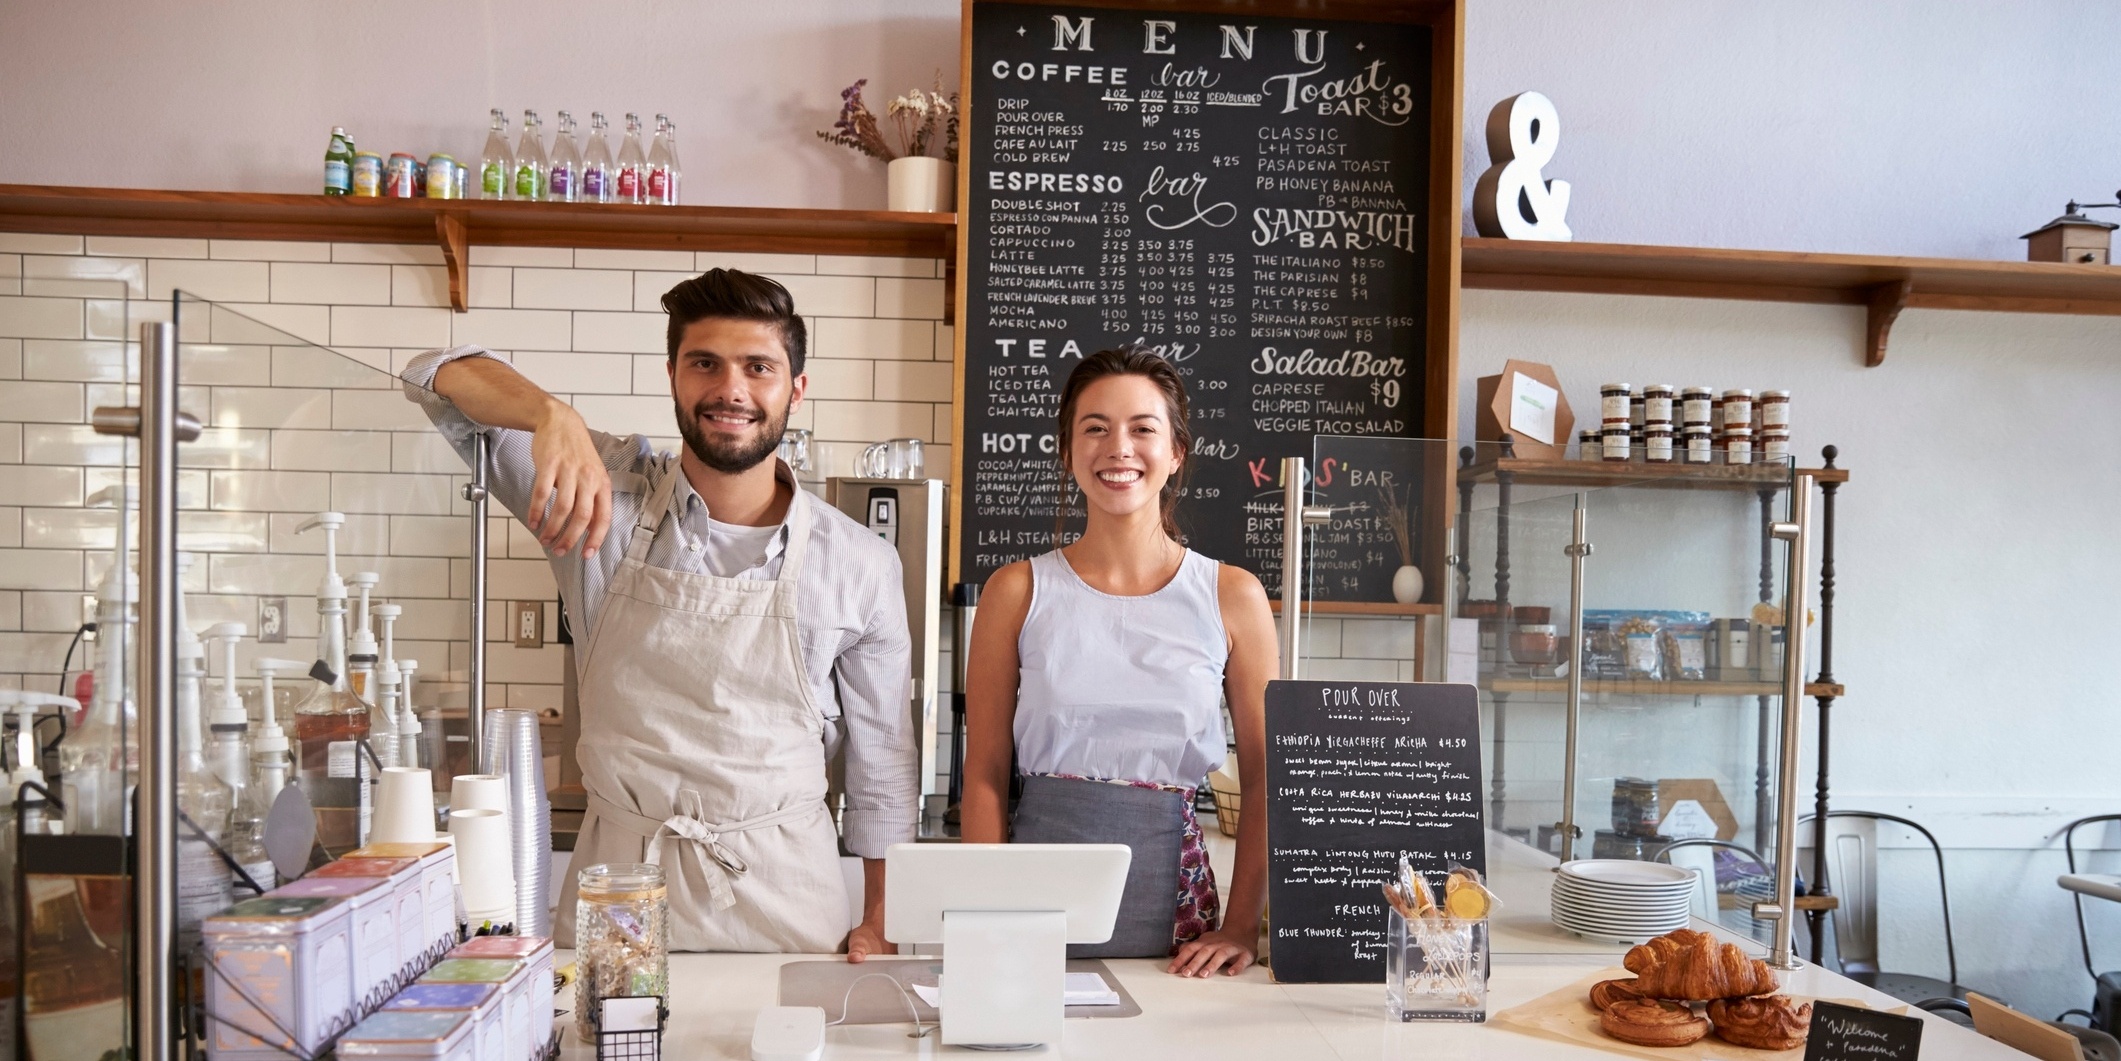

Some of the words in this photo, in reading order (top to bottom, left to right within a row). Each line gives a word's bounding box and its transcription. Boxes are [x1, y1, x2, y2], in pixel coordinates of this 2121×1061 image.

[1051, 15, 1327, 64] MENU
[992, 60, 1127, 85] COFFEE
[1151, 62, 1220, 88] bar
[1262, 57, 1390, 116] Toast
[998, 99, 1029, 109] DRIP
[1108, 103, 1128, 111] 1.70
[1174, 105, 1198, 114] 2.30
[997, 112, 1029, 122] POUR
[1032, 112, 1064, 122] OVER
[1143, 115, 1159, 127] MP
[995, 125, 1043, 136] FRENCH
[1048, 125, 1083, 136] PRESS
[1259, 127, 1338, 141] CLASSIC
[994, 139, 1025, 149] CAFE
[1029, 139, 1045, 148] AU
[1050, 140, 1078, 150] LAIT
[1259, 143, 1289, 154] L+H
[1296, 144, 1347, 155] TOAST
[994, 153, 1027, 162] COLD
[1033, 153, 1070, 162] BREW
[1258, 158, 1336, 171] PASADENA
[1342, 160, 1391, 172] TOAST
[1486, 91, 1572, 242] &
[1257, 176, 1274, 190] PB
[1280, 177, 1328, 193] HONEY
[1333, 179, 1393, 193] BANANA
[989, 171, 1122, 193] ESPRESSO
[1140, 166, 1237, 229] bar
[1319, 194, 1335, 208] PB
[1352, 196, 1406, 211] BANANA
[992, 199, 1042, 210] DOUBLE
[1045, 201, 1080, 212] SHOT
[1101, 202, 1126, 212] 2.25
[990, 213, 1039, 222] ESPRESSO
[1042, 214, 1059, 222] CON
[1061, 214, 1097, 224] PANNA
[990, 225, 1050, 235] CORTADO
[1252, 208, 1415, 253] SANDWICH
[990, 238, 1075, 248] CAPPUCCINO
[1168, 240, 1193, 250] 3.75
[1299, 231, 1372, 250] BAR
[991, 250, 1034, 260] LATTE
[1208, 253, 1234, 263] 3.75
[1253, 255, 1277, 265] THE
[1282, 256, 1340, 268] ITALIANO
[1352, 256, 1384, 268] $8.50
[990, 262, 1045, 274] HONEYBEE
[1050, 265, 1084, 275] LATTE
[988, 277, 1023, 286] SALTED
[1024, 279, 1065, 289] CARAMEL
[1068, 281, 1095, 289] LATTE
[1253, 270, 1276, 280] THE
[1281, 272, 1338, 283] PARISIAN
[1351, 273, 1366, 285] $8
[988, 292, 1021, 301] FRENCH
[1024, 293, 1068, 305] LAVENDER
[1071, 295, 1096, 305] BREVE
[1254, 286, 1276, 296] THE
[1280, 287, 1337, 298] CAPRESE
[1351, 287, 1367, 300] $9
[990, 306, 1034, 315] MOCHA
[1293, 299, 1329, 311] $8.50
[989, 318, 1067, 329] AMERICANO
[1251, 313, 1306, 325] SRIRACHA
[1310, 316, 1348, 327] ROAST
[1351, 317, 1381, 326] BEEF
[1251, 328, 1291, 337] DESIGN
[1293, 329, 1320, 339] YOUR
[1324, 330, 1347, 339] OWN
[1356, 329, 1372, 343] $8
[995, 339, 1083, 359] TEA
[989, 366, 1016, 377] HOT
[1022, 365, 1049, 375] TEA
[989, 380, 1022, 391] ICED
[1025, 380, 1051, 390] TEA
[1198, 380, 1227, 390] 3.00
[1252, 383, 1324, 395] CAPRESE
[1371, 378, 1400, 407] $9
[989, 394, 1017, 403] TEA
[988, 406, 1018, 416] CHAI
[1021, 407, 1045, 417] TEA
[1252, 399, 1310, 413] CHOPPED
[1316, 400, 1364, 415] ITALIAN
[1254, 418, 1311, 432] VEGGIE
[1315, 419, 1351, 433] TACO
[1355, 420, 1403, 434] SALAD
[983, 433, 1032, 453] HOT
[1189, 436, 1240, 460] bar
[1351, 470, 1396, 487] BAR
[1195, 488, 1220, 499] 3.50
[979, 530, 1010, 545] L&H
[1246, 533, 1259, 544] PB
[1328, 533, 1349, 544] JAM
[1367, 550, 1383, 566] $4
[1342, 576, 1358, 590] $4
[1322, 687, 1360, 706] POUR
[1369, 689, 1400, 706] OVER
[1439, 738, 1466, 748] $4.50
[1274, 848, 1317, 856] SUMATRA
[1400, 850, 1436, 860] BATAK
[1444, 851, 1472, 860] $4.15
[1335, 904, 1380, 916] FRENCH
[1279, 928, 1298, 937] BLUE
[1304, 927, 1347, 937] THUNDER:
